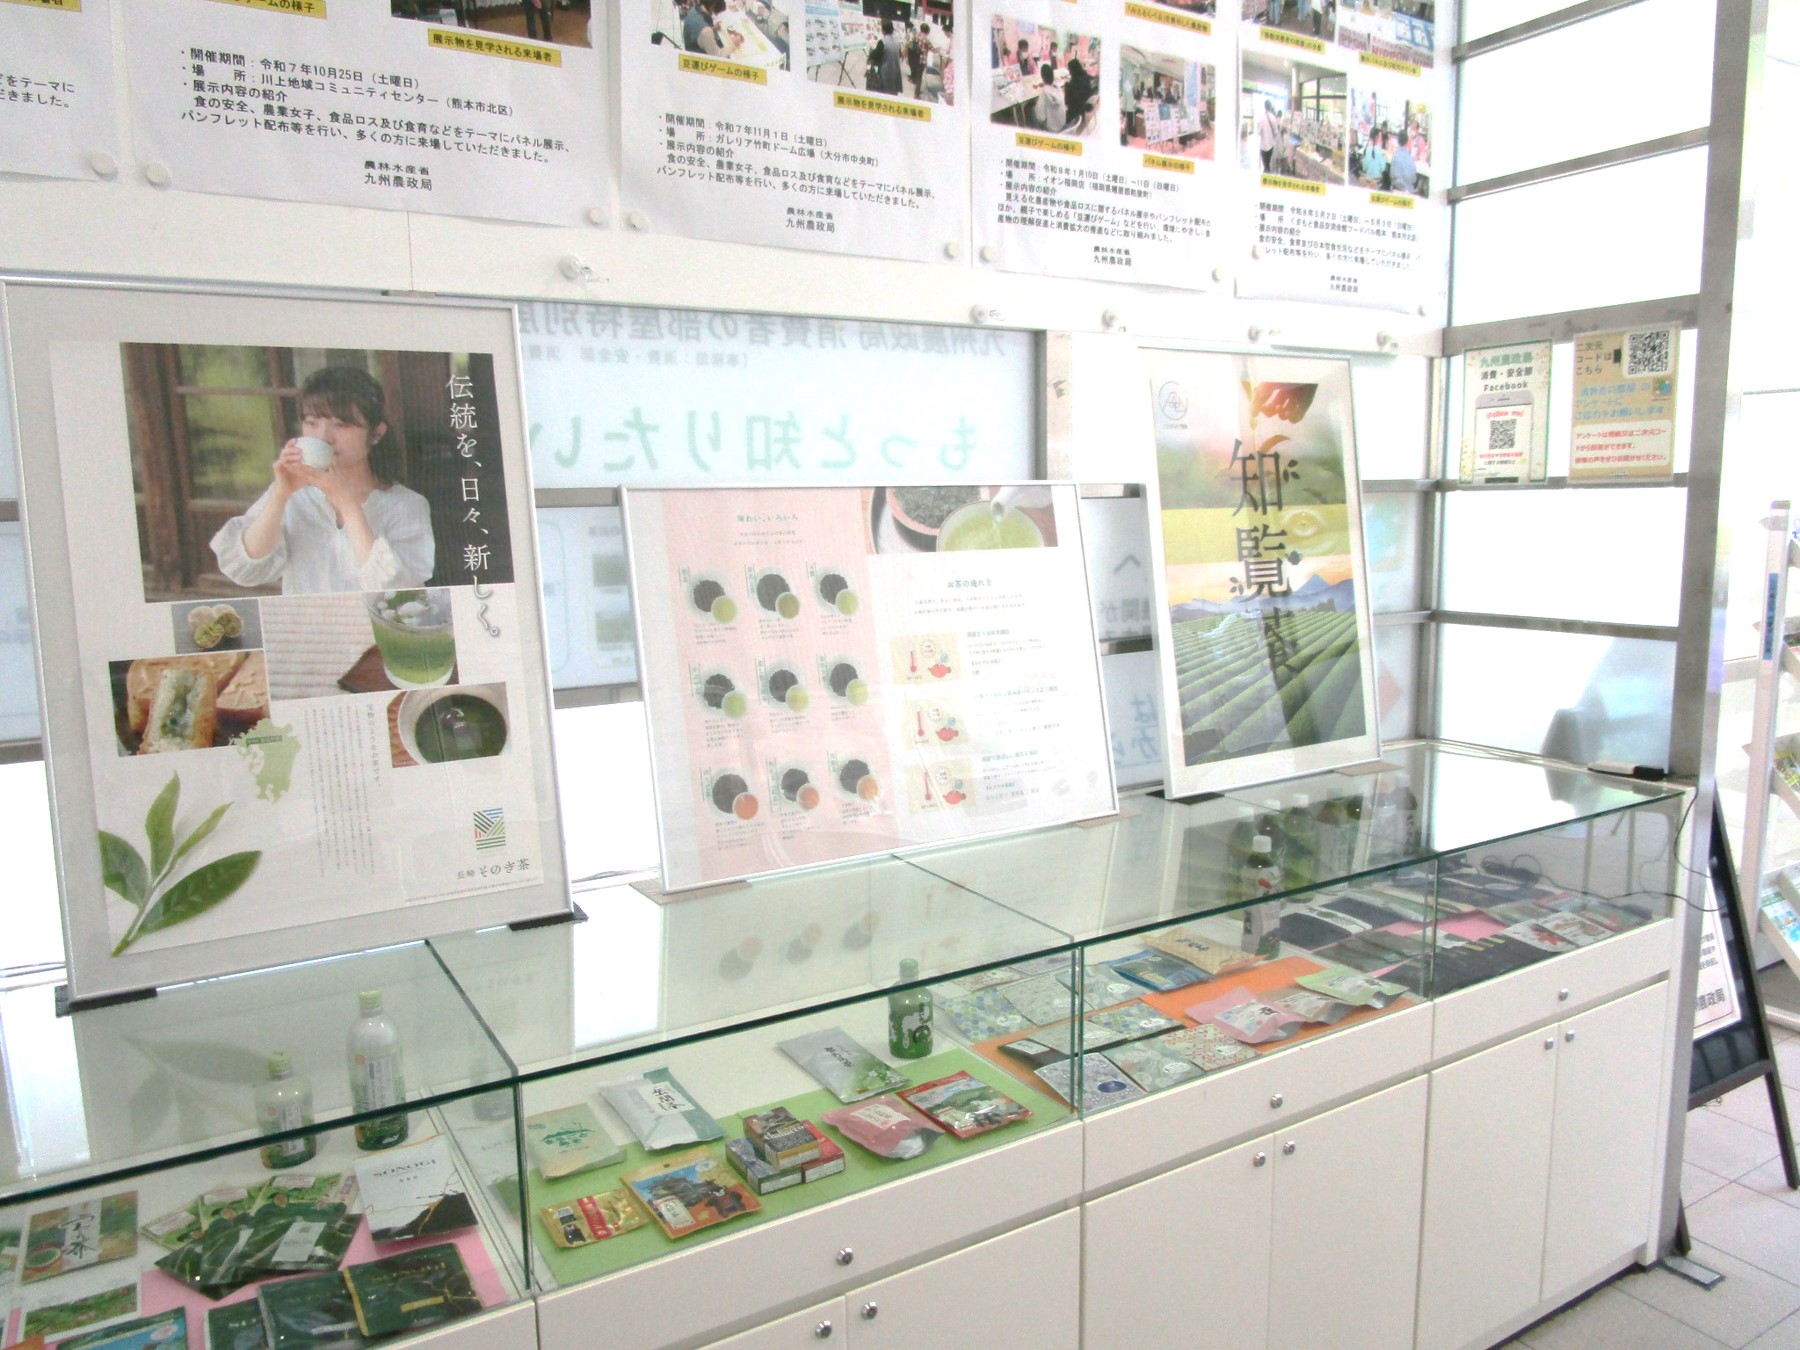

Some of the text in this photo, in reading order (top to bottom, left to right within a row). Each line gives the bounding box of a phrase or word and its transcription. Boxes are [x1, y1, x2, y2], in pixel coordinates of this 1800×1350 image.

[433, 33, 553, 62] 展示物を見学される来場者
[364, 160, 430, 175] 農林水産省
[364, 172, 433, 191] 九州農政局
[786, 207, 833, 220] 農林水産省
[786, 218, 835, 233] 九州農政局
[1480, 351, 1533, 368] 九州農政局
[1480, 366, 1533, 381] 消費・安全部
[1483, 380, 1528, 392] Facebook
[446, 374, 500, 637] 伝統を、日々、新しく。
